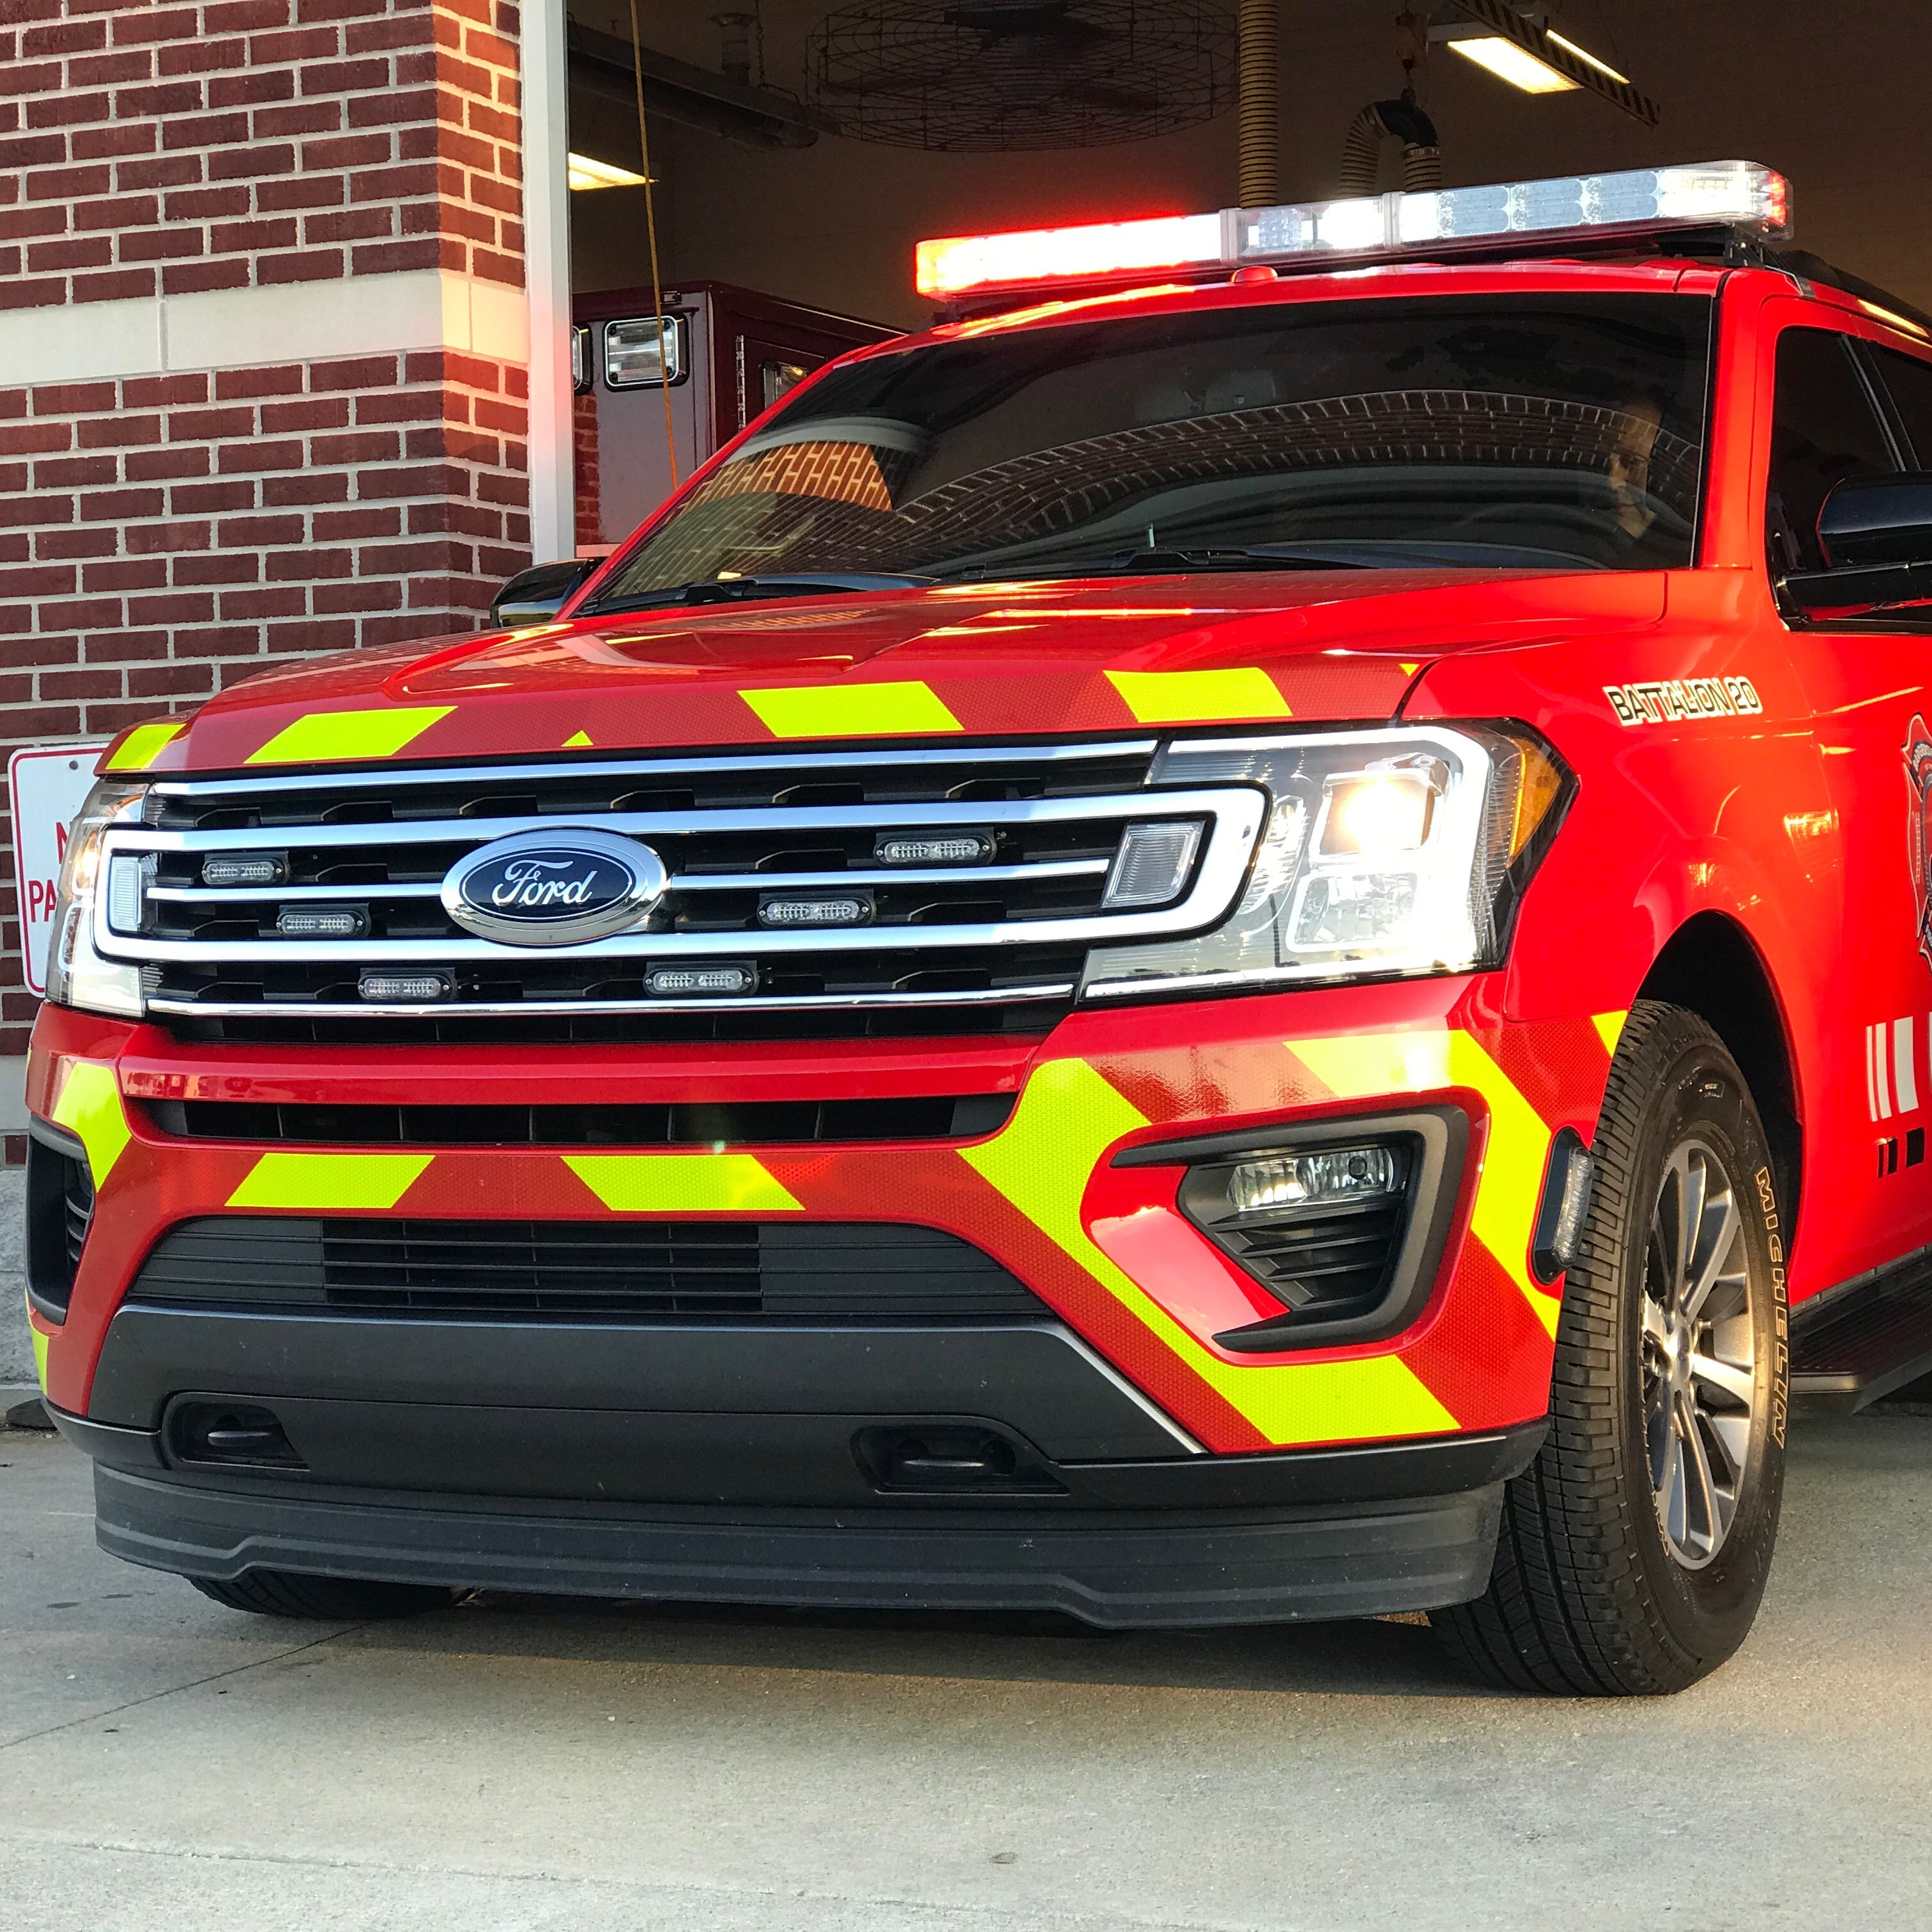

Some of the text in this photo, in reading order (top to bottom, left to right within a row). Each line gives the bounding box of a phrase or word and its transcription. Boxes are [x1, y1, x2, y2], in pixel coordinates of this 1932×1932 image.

[1604, 677, 1761, 724] BATTALION 20
[492, 859, 597, 906] Ford
[1754, 1165, 1788, 1450] MICHELIN
